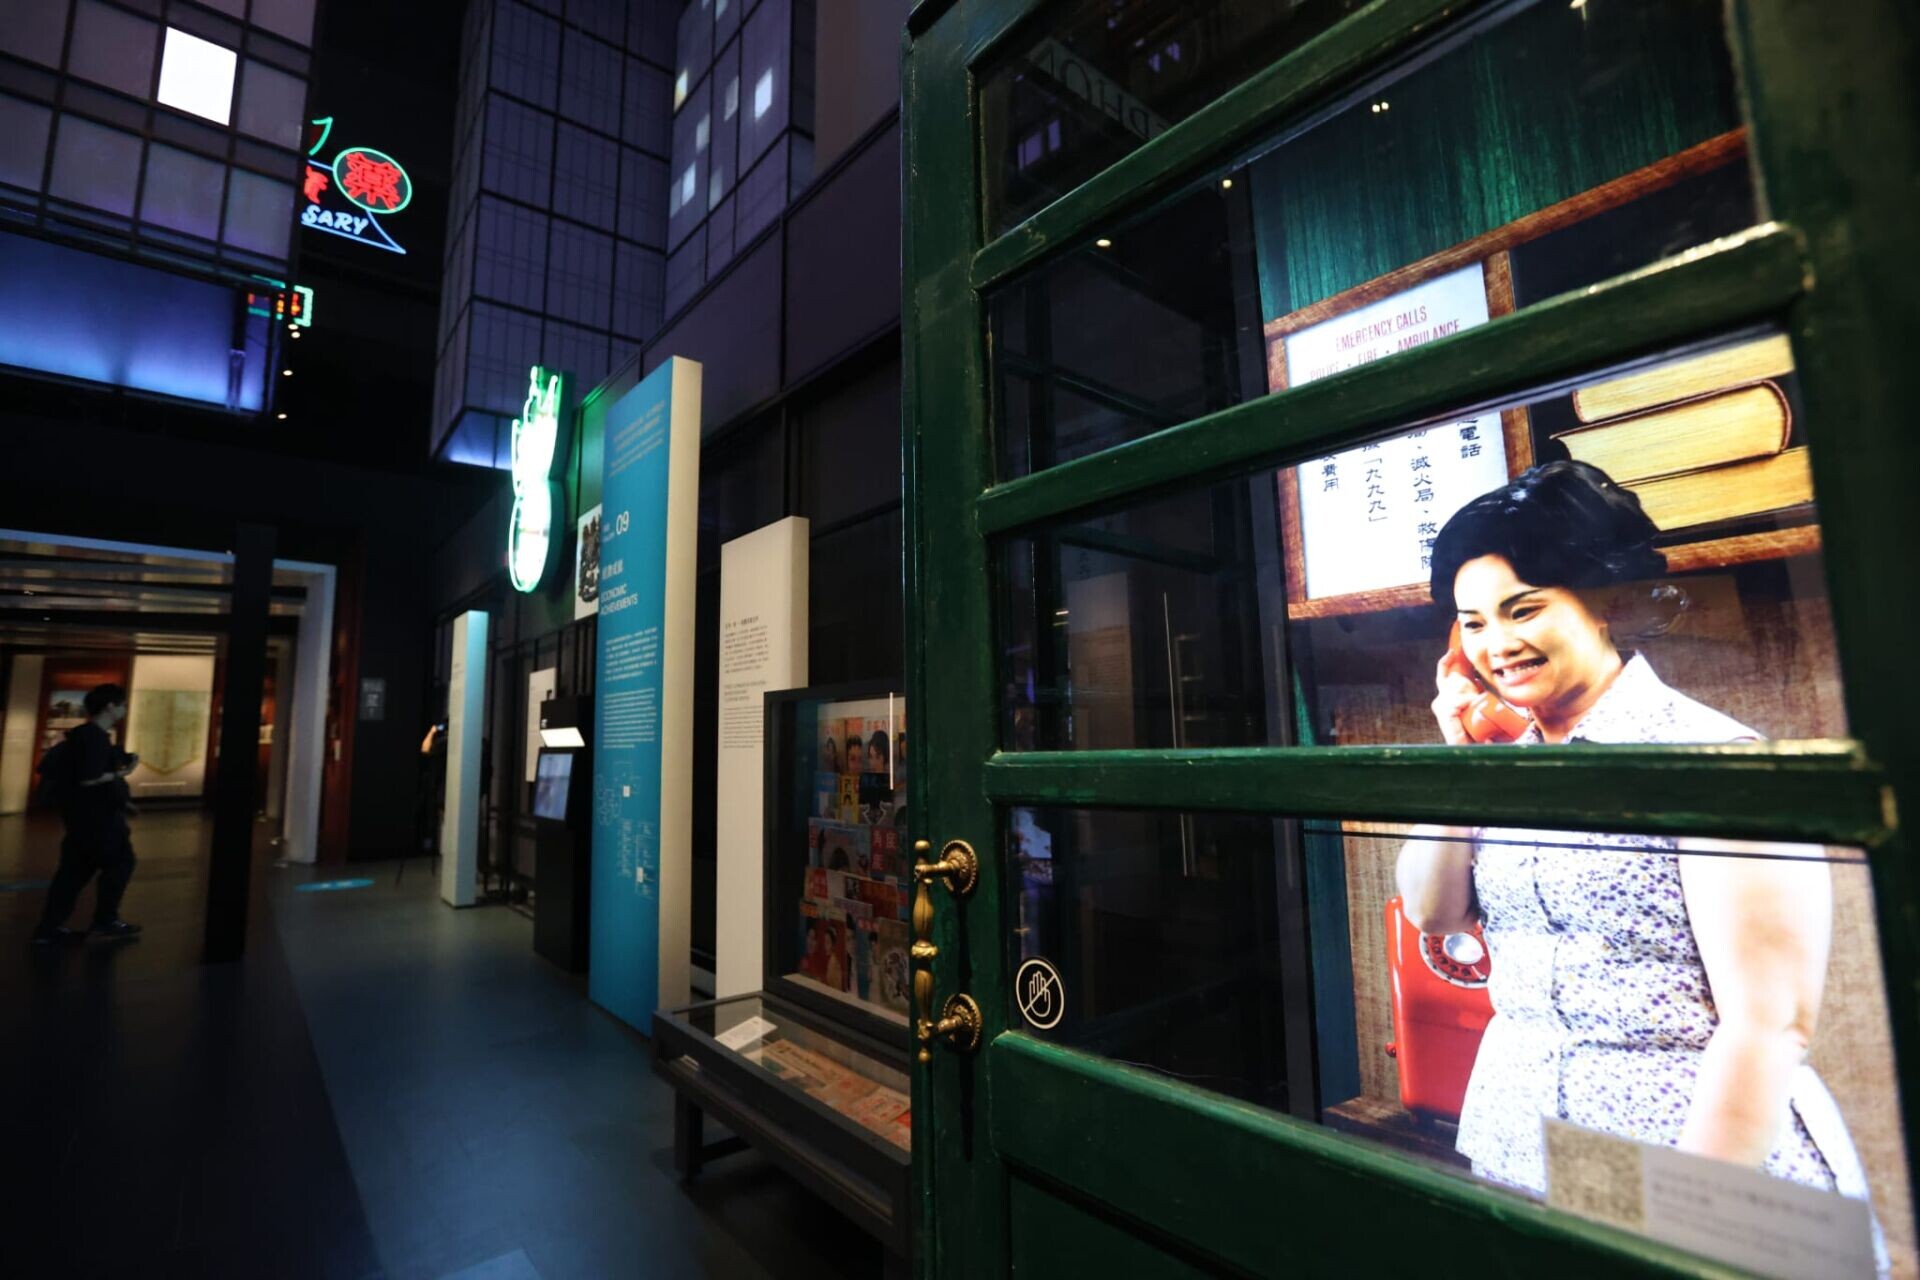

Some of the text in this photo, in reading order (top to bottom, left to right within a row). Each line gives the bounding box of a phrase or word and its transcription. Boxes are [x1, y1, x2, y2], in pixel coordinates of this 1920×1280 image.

[1336, 305, 1427, 352] EMERGENCY CALLS
[1397, 319, 1460, 351] AMBULANCE
[616, 510, 630, 535] 09
